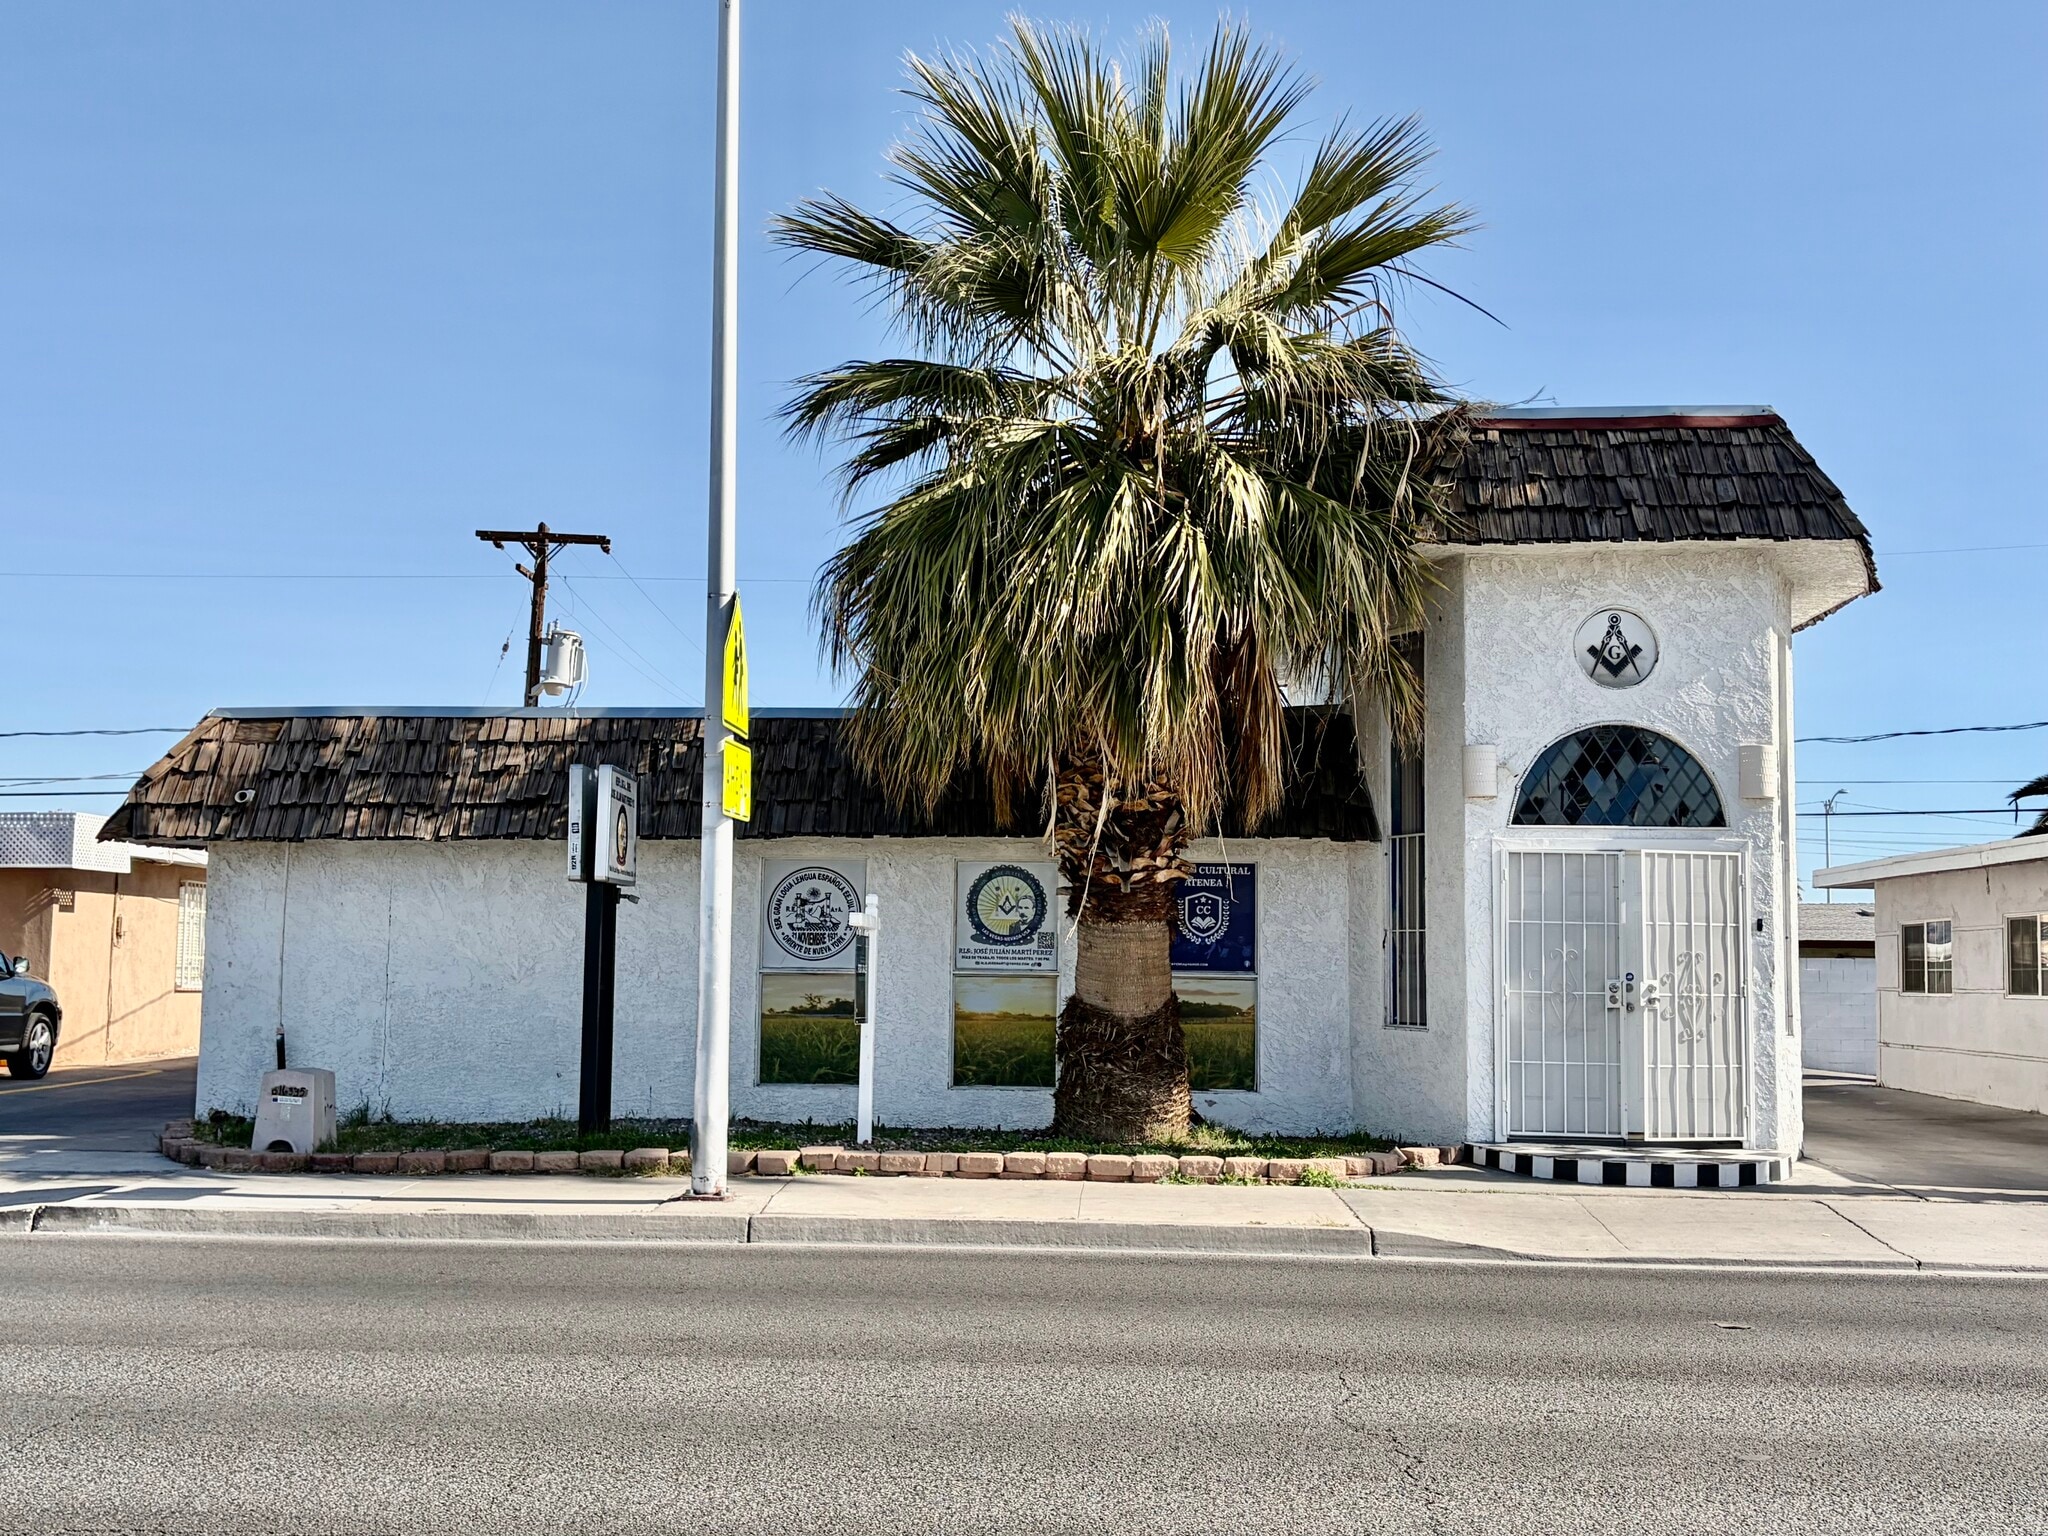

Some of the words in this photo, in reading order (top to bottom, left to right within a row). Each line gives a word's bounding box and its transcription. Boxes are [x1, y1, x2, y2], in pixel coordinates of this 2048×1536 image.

[1608, 645, 1621, 660] G
[1198, 866, 1251, 875] CULTURAL
[1184, 879, 1223, 887] ATENEA
[773, 895, 783, 915] GRAN
[780, 882, 795, 899] LOGIA
[792, 872, 817, 885] LENGUA
[817, 872, 845, 893] ESPAÑOLA
[1196, 905, 1211, 914] CC
[783, 935, 803, 953] ORIENTE
[803, 946, 811, 955] DE
[812, 945, 832, 955] NUEVA
[831, 936, 845, 949] YORK
